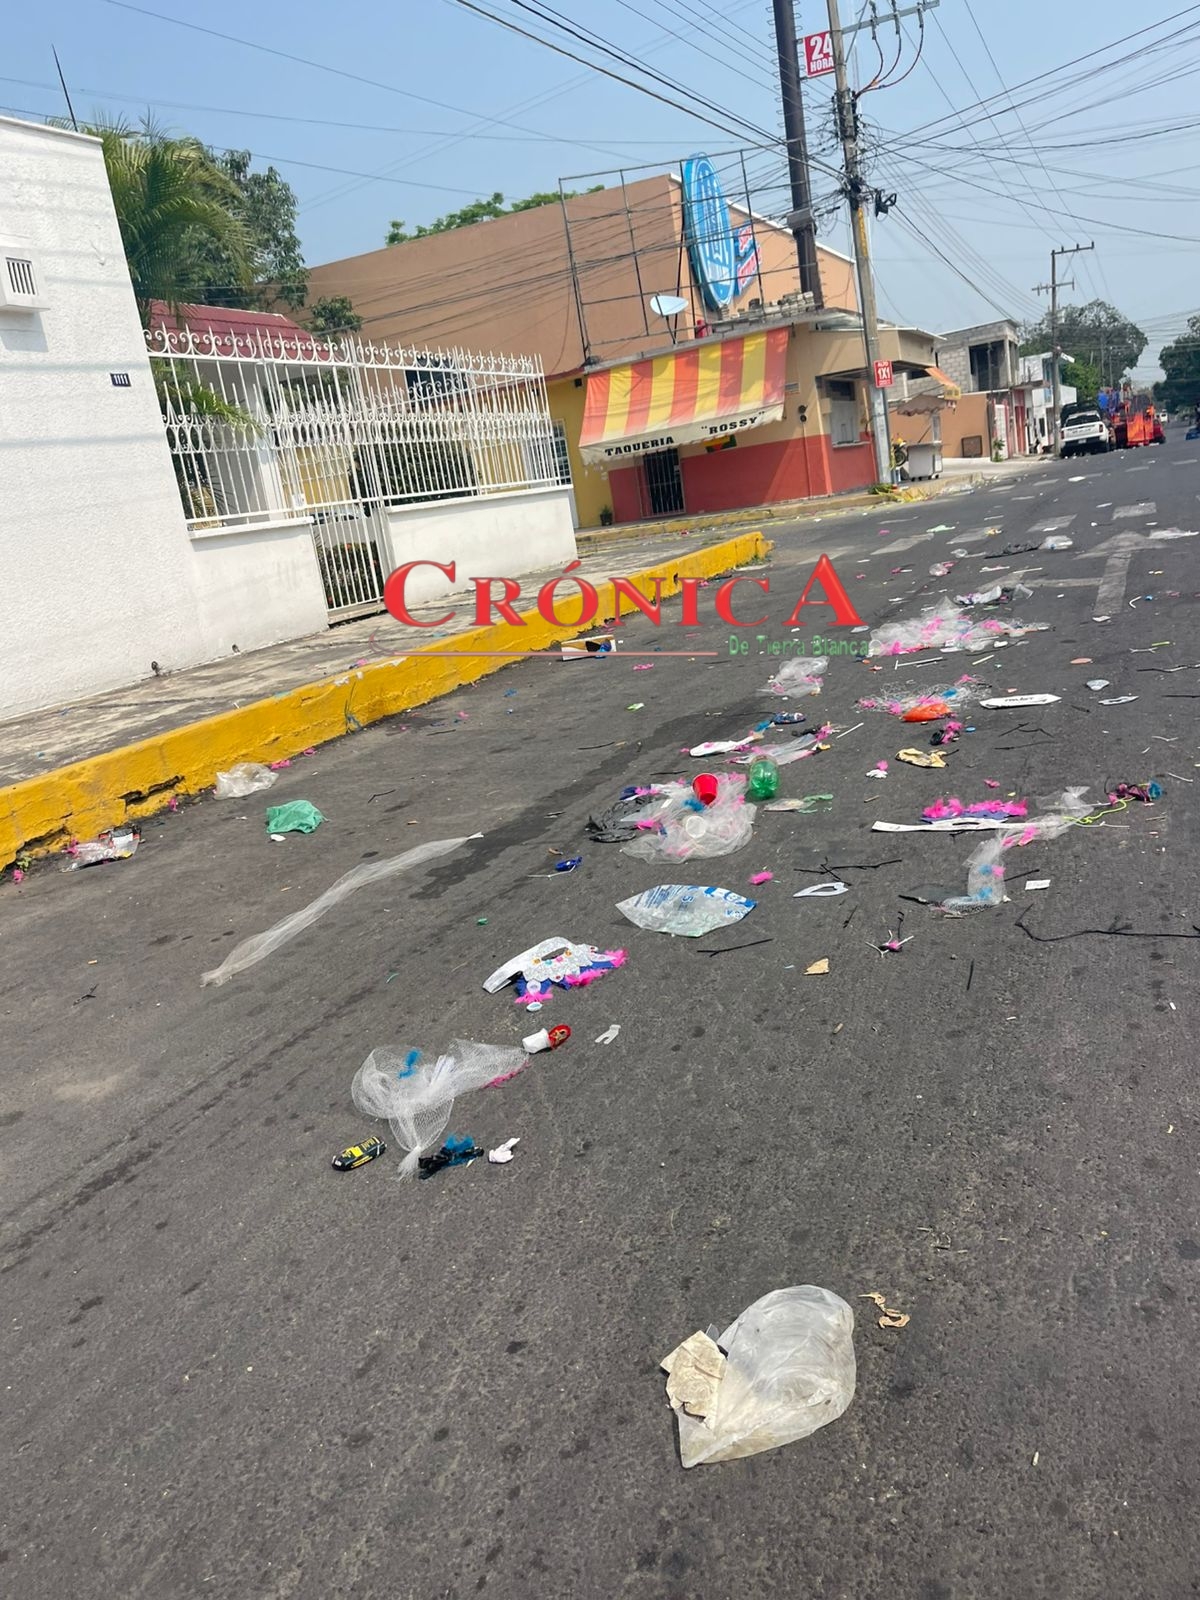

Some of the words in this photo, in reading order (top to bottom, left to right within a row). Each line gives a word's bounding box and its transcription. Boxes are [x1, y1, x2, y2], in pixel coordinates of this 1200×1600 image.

[810, 35, 833, 60] 24
[810, 58, 834, 72] HORA
[114, 374, 129, 385] 1111
[878, 367, 890, 379] 1X1
[604, 436, 675, 457] TAQUERIA
